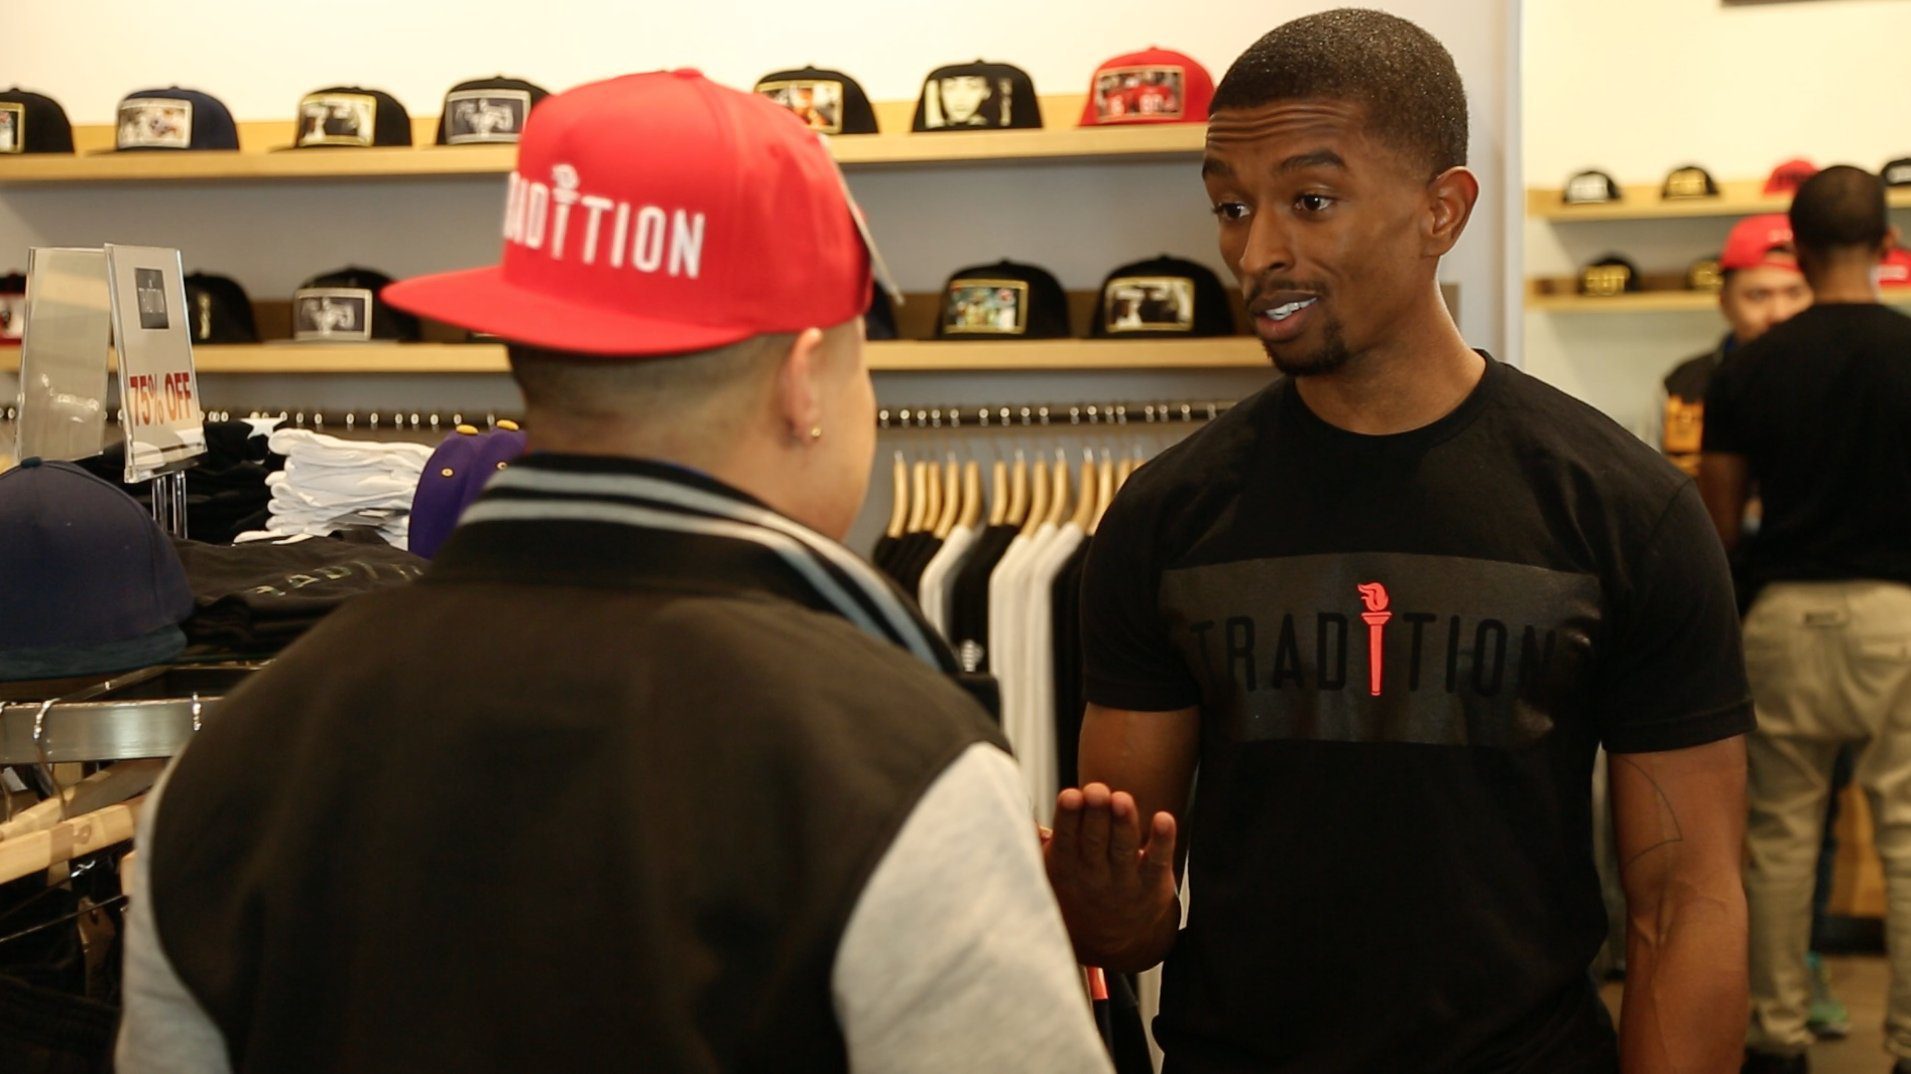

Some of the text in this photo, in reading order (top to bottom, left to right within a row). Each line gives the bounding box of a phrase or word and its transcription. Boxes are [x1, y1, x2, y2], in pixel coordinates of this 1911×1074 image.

[130, 372, 192, 427] 75% OFF
[1189, 581, 1557, 697] TRADITION
